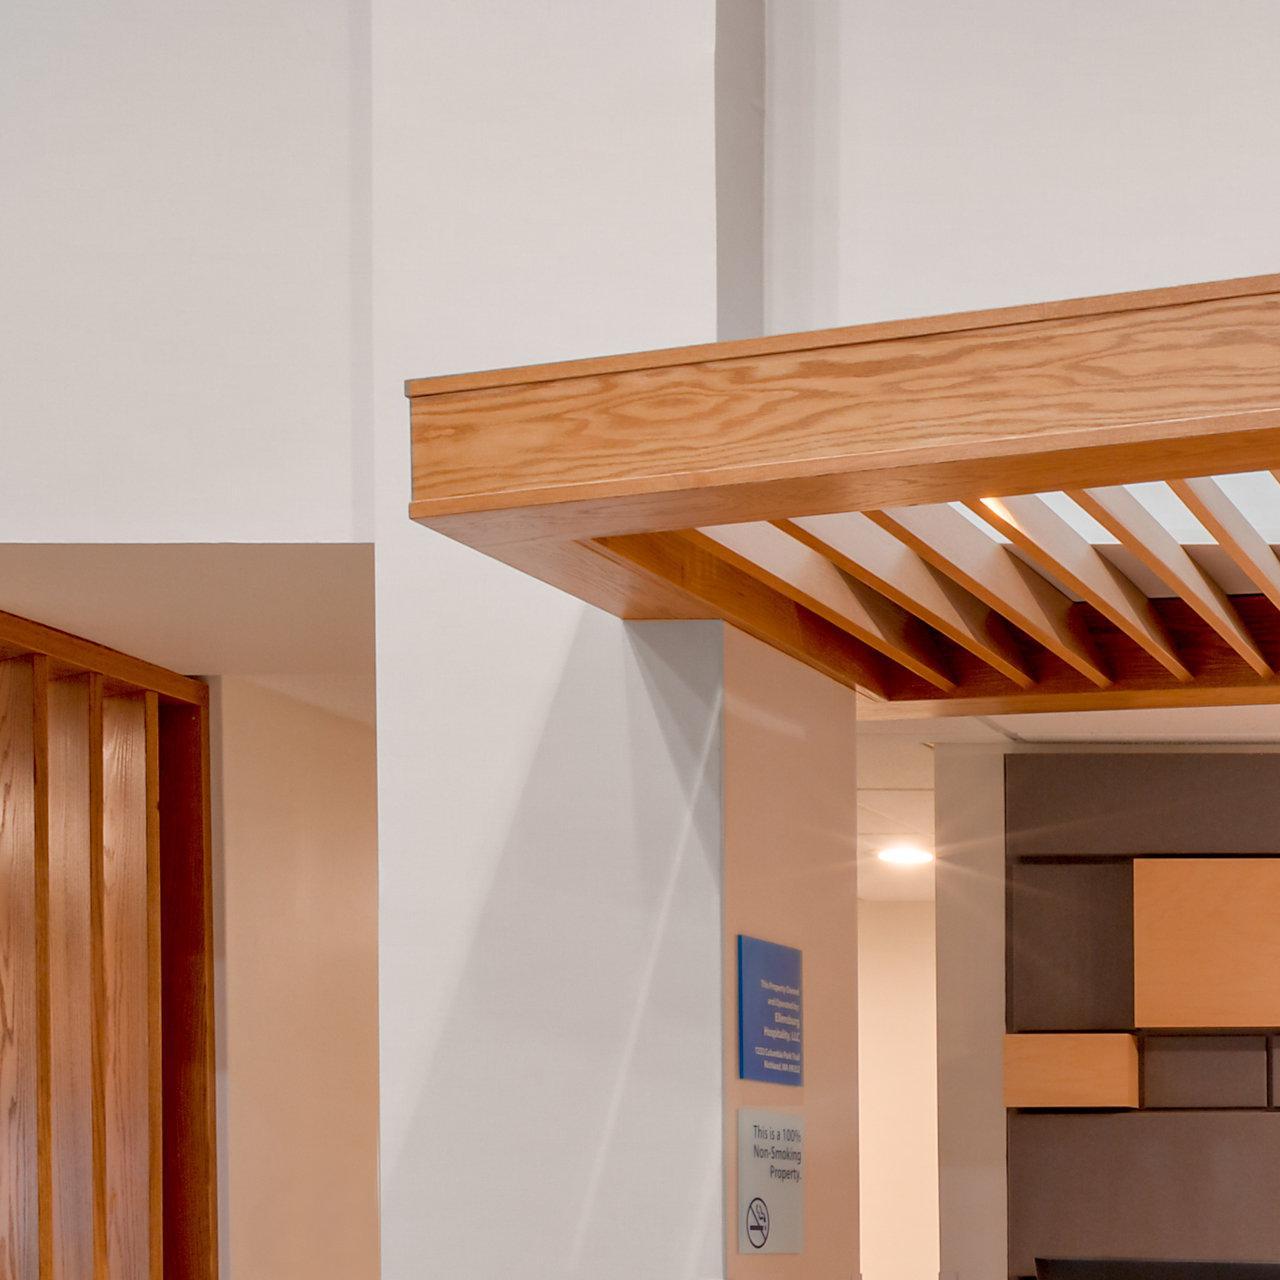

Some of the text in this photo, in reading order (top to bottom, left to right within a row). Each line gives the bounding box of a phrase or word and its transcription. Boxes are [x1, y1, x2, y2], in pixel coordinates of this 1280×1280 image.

[753, 1124, 801, 1142] This is a 100%
[753, 1145, 802, 1165] Non-Smoking
